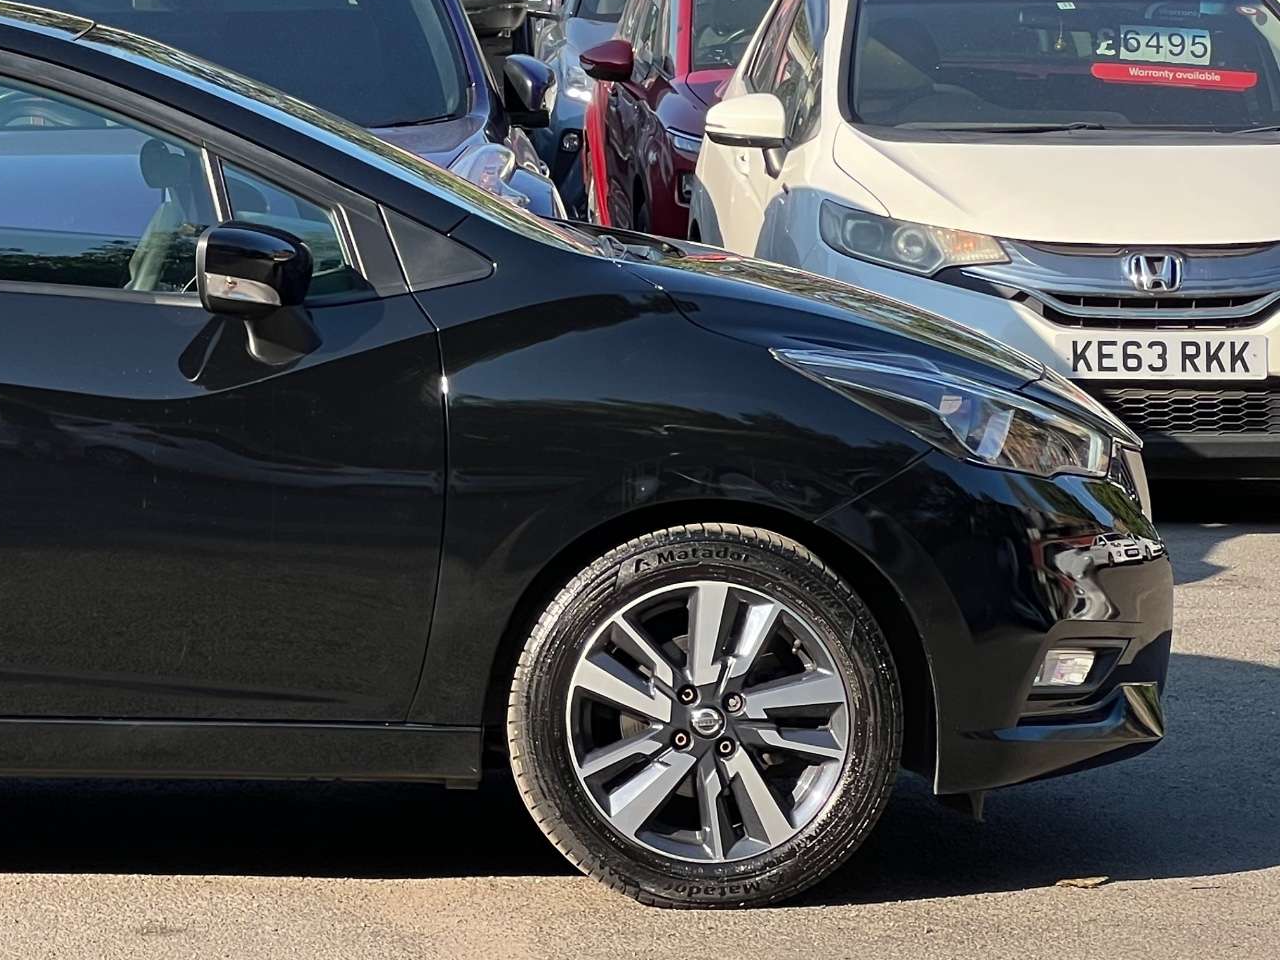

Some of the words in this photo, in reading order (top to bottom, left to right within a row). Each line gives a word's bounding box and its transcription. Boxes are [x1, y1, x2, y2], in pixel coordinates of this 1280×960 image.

[1128, 67, 1174, 81] Warranty
[1175, 70, 1221, 82] available
[1071, 340, 1168, 373] KE63
[1180, 340, 1251, 373] RKK
[656, 546, 751, 566] Matador
